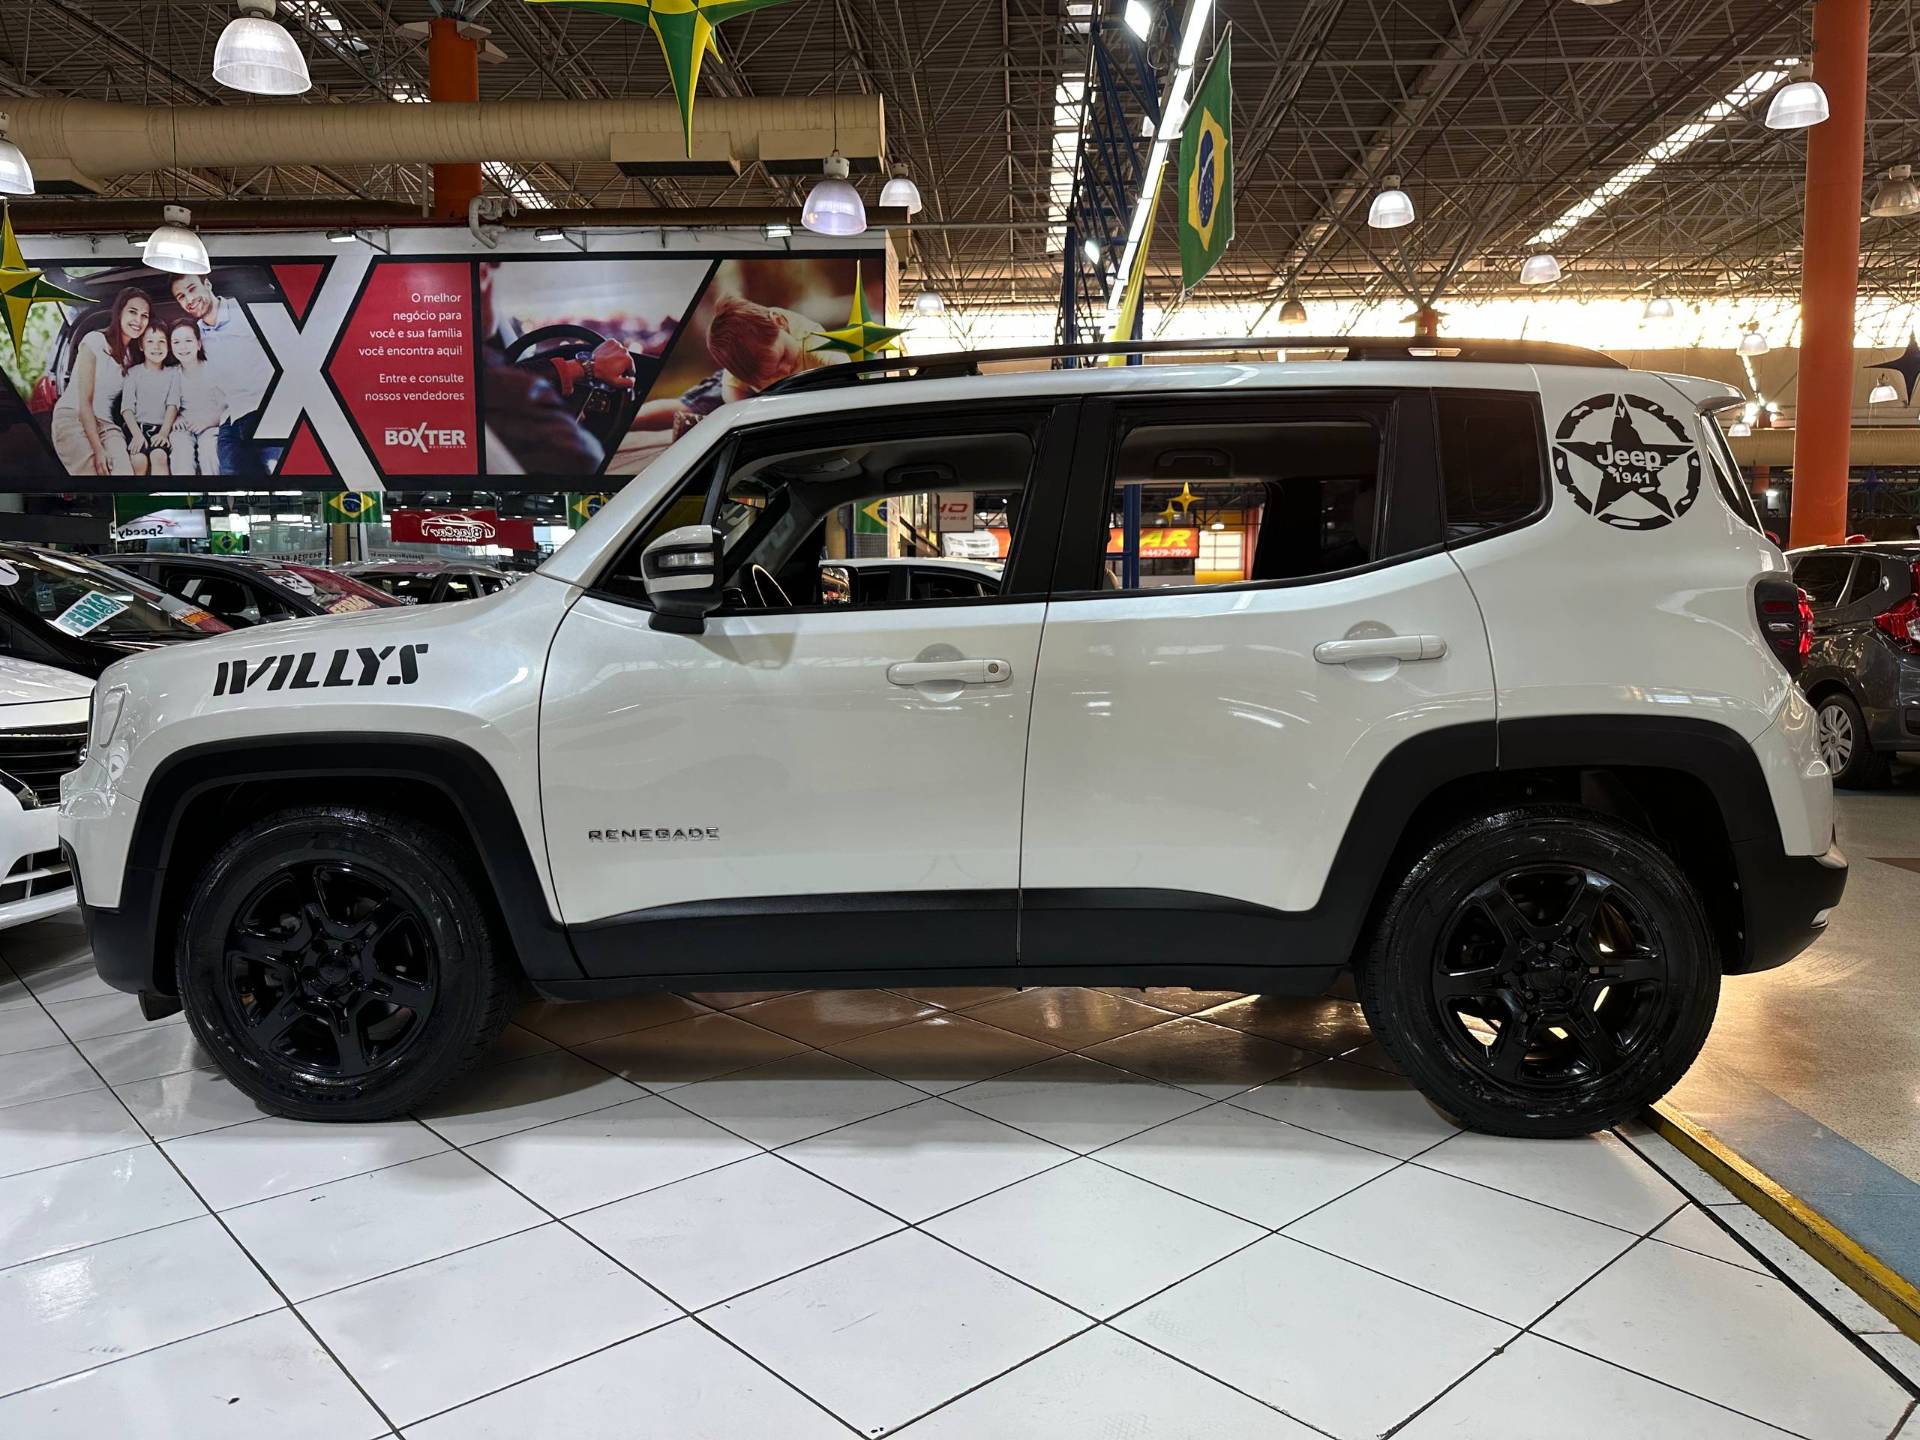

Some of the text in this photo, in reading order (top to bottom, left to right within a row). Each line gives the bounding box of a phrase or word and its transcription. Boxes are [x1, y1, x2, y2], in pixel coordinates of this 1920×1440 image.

[411, 293, 462, 303] O melhor
[393, 310, 462, 323] negócio para
[369, 327, 463, 338] você e sua família
[359, 345, 463, 359] você encontra aqui!
[379, 373, 464, 383] Entre e consulte
[365, 391, 465, 401] nossos vendedores
[384, 422, 467, 453] BOXTER
[1596, 444, 1662, 471] Jeep
[1613, 472, 1651, 484] 1941
[213, 643, 429, 697] WILLYS
[588, 827, 720, 842] RENEGADE
